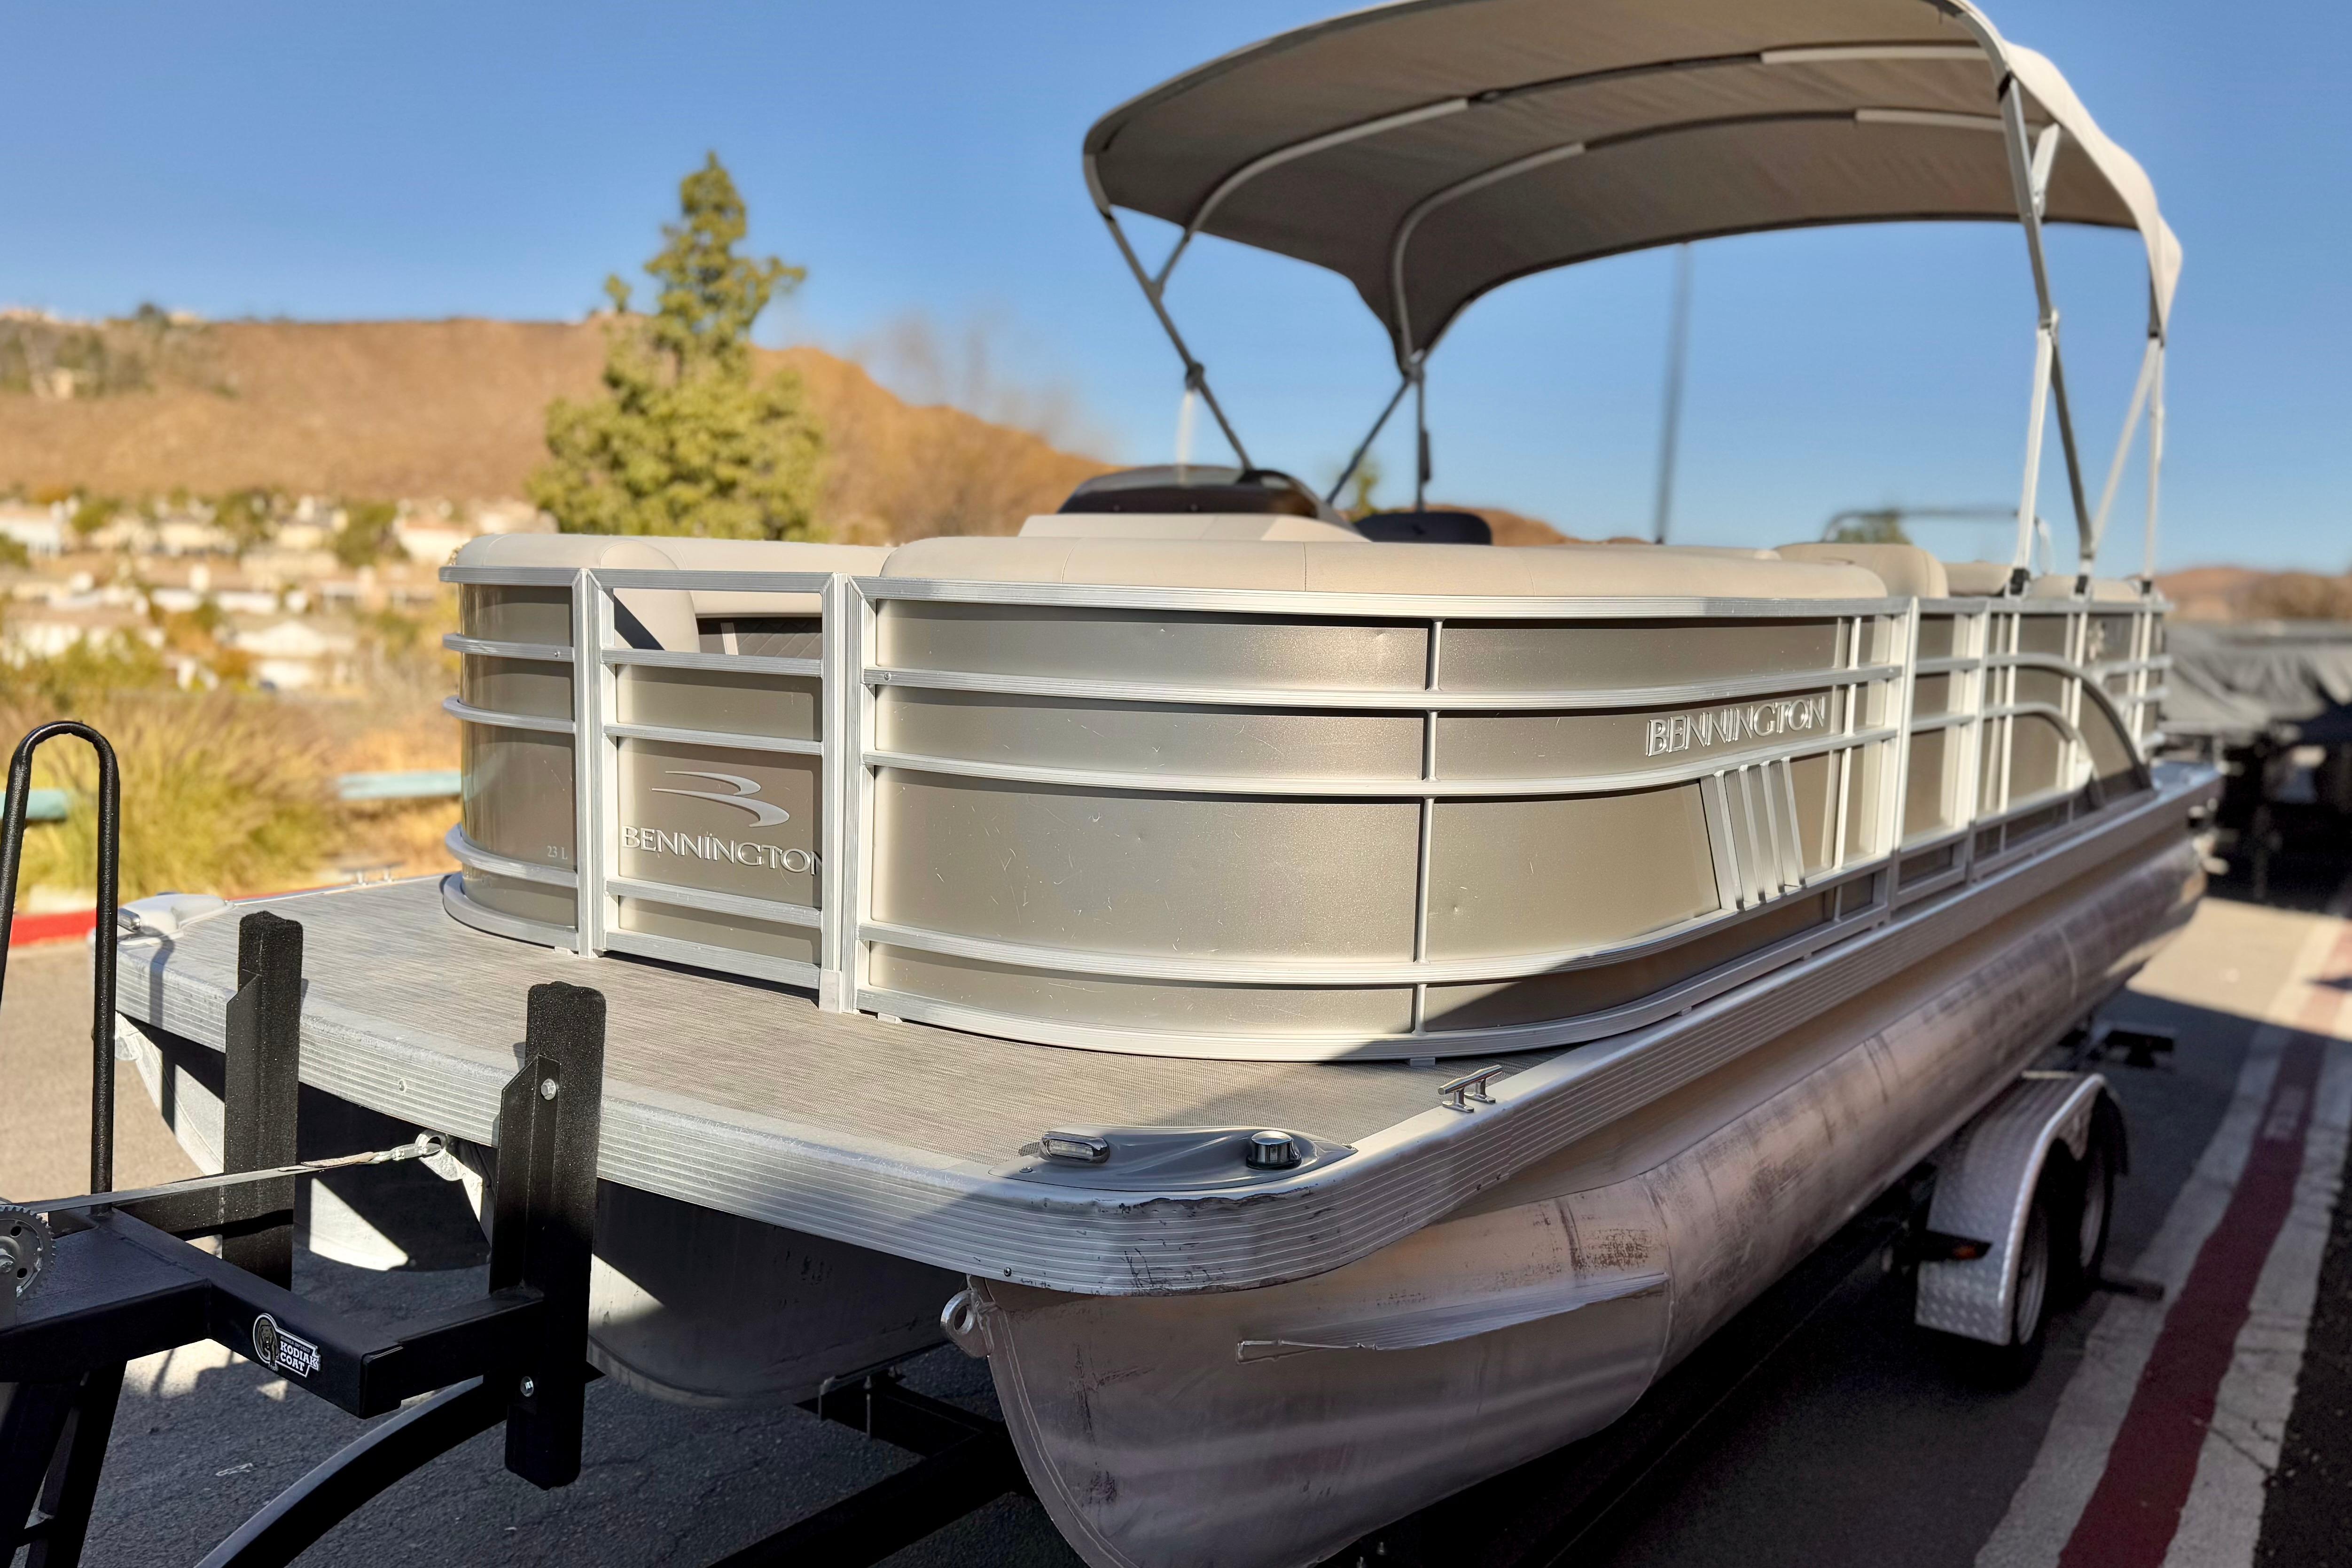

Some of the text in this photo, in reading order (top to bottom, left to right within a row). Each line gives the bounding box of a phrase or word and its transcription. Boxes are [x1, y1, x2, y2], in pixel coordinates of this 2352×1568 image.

[1646, 696, 1826, 757] BENNINGTON
[547, 845, 557, 858] 23
[280, 1341, 317, 1367] KODIAK
[281, 1353, 305, 1371] COAT
